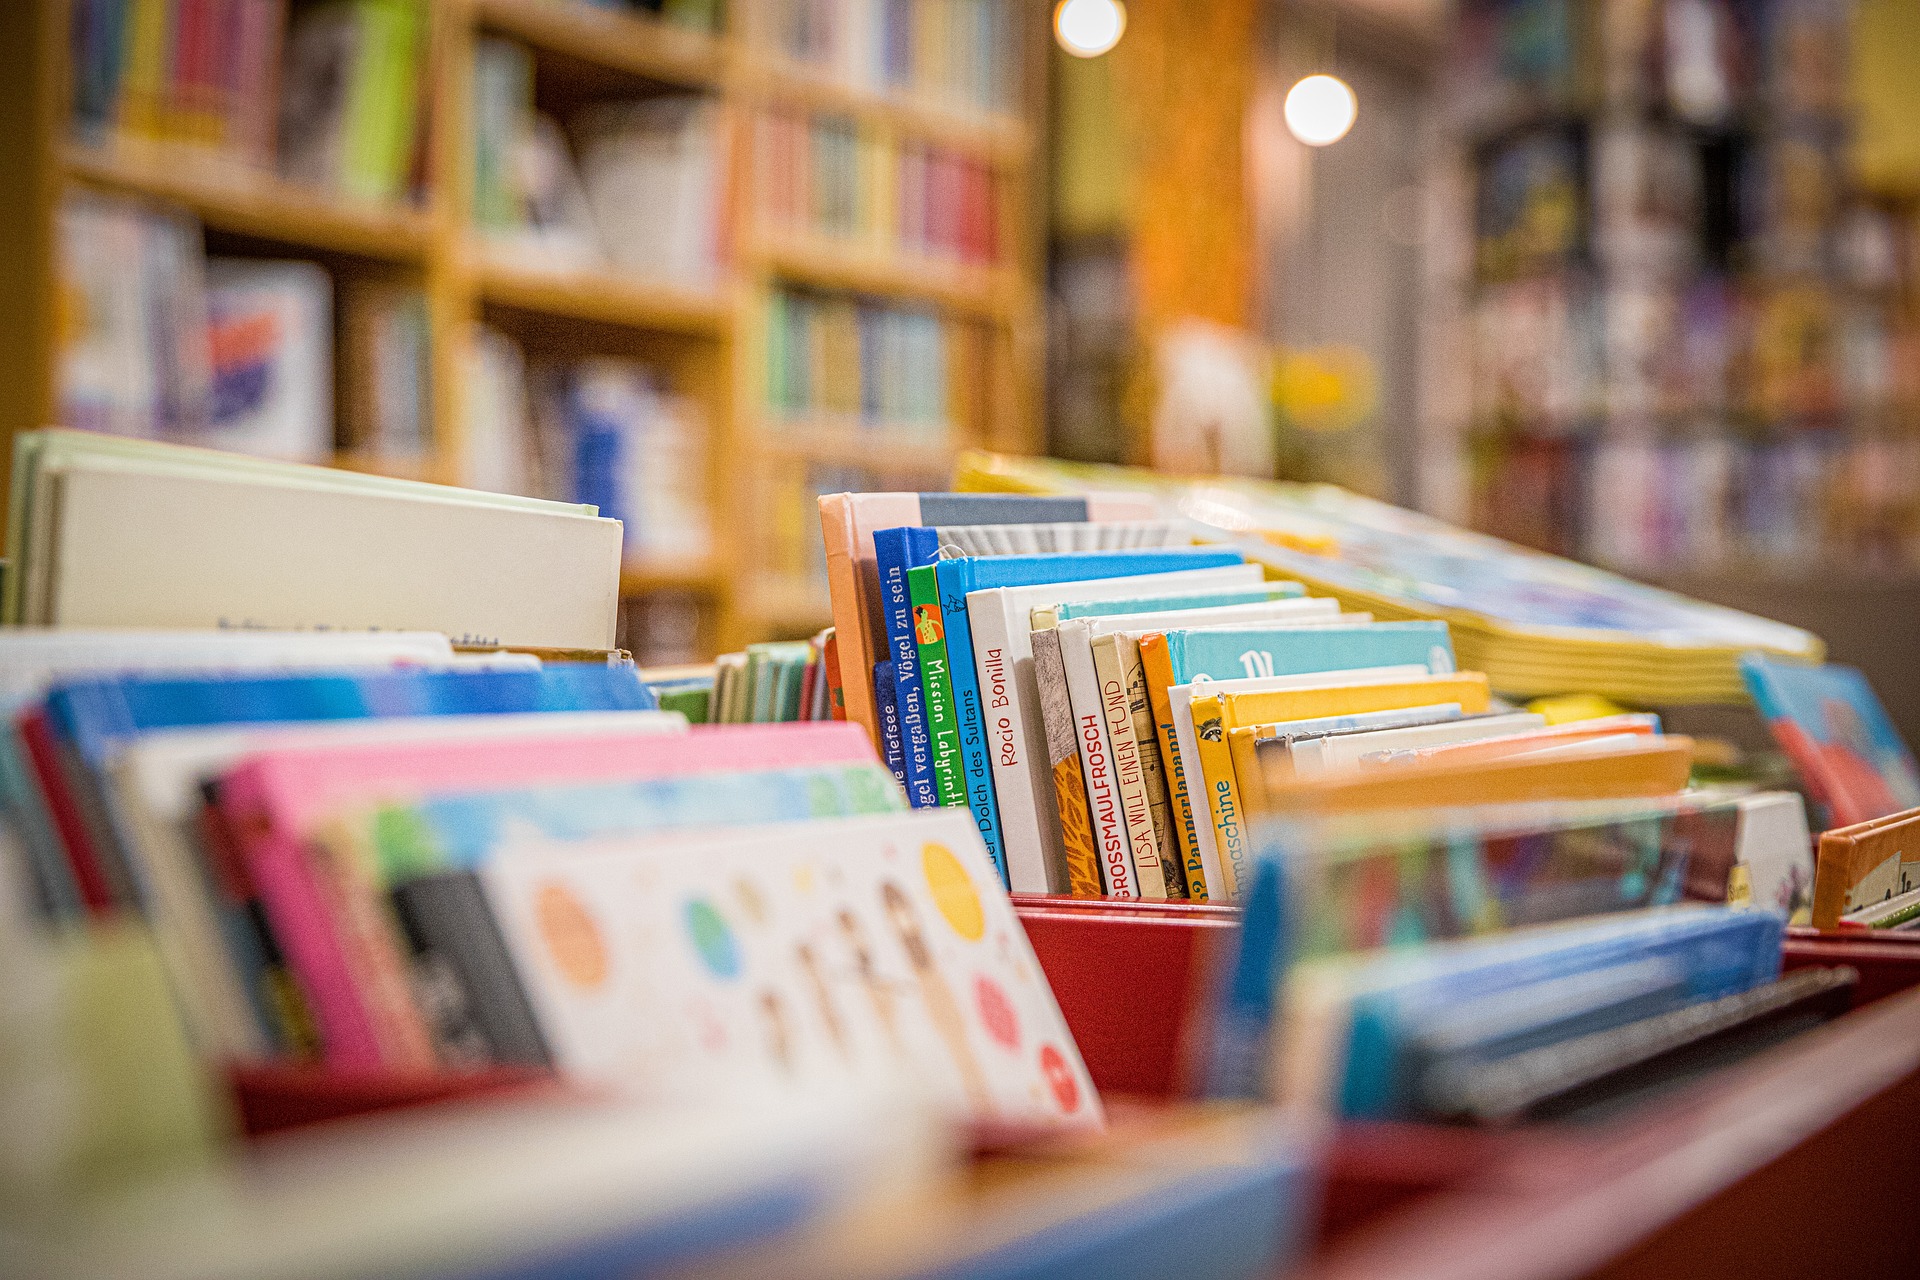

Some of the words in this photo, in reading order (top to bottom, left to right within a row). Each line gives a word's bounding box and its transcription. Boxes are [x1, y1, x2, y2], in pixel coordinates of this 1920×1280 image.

[886, 566, 904, 603] sein
[896, 608, 909, 630] zu
[895, 634, 915, 682] Vögel
[985, 648, 1009, 708] Bonilla
[926, 659, 945, 723] Mission
[1104, 680, 1130, 735] HUND
[885, 704, 901, 765] Tiefsee
[905, 686, 927, 773] vergaßen,
[963, 689, 980, 745] Sultans
[970, 751, 984, 778] des
[996, 717, 1018, 766] Rocio
[1116, 741, 1139, 785] EINEN
[935, 730, 964, 810] Labyrinth
[914, 778, 936, 814] ögel
[973, 784, 992, 832] Dolch
[1081, 715, 1130, 897] GROSSMAULFROSCH
[1126, 789, 1146, 827] WILL
[1134, 829, 1159, 867] LISA
